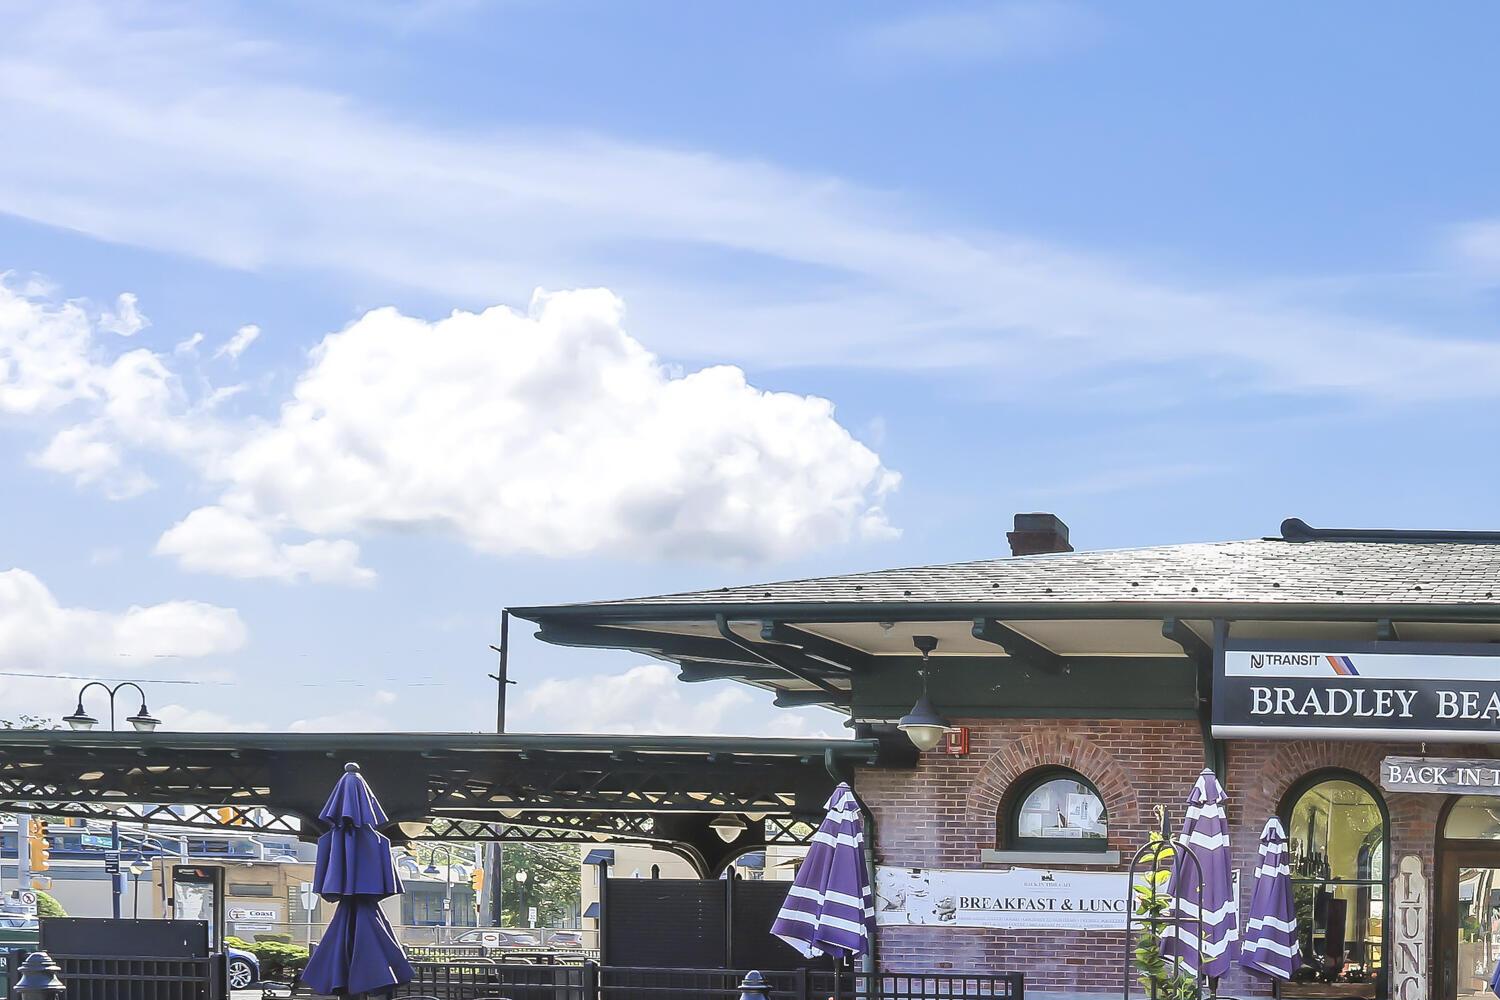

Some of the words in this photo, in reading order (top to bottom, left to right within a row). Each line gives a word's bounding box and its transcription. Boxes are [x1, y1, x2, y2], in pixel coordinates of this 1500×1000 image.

[1266, 654, 1320, 666] TRANSIT
[1249, 686, 1418, 718] BRADLEY
[1388, 765, 1448, 784] BACK
[1456, 768, 1481, 786] IN
[959, 896, 1056, 910] BREAKFAST
[1060, 899, 1073, 911] &
